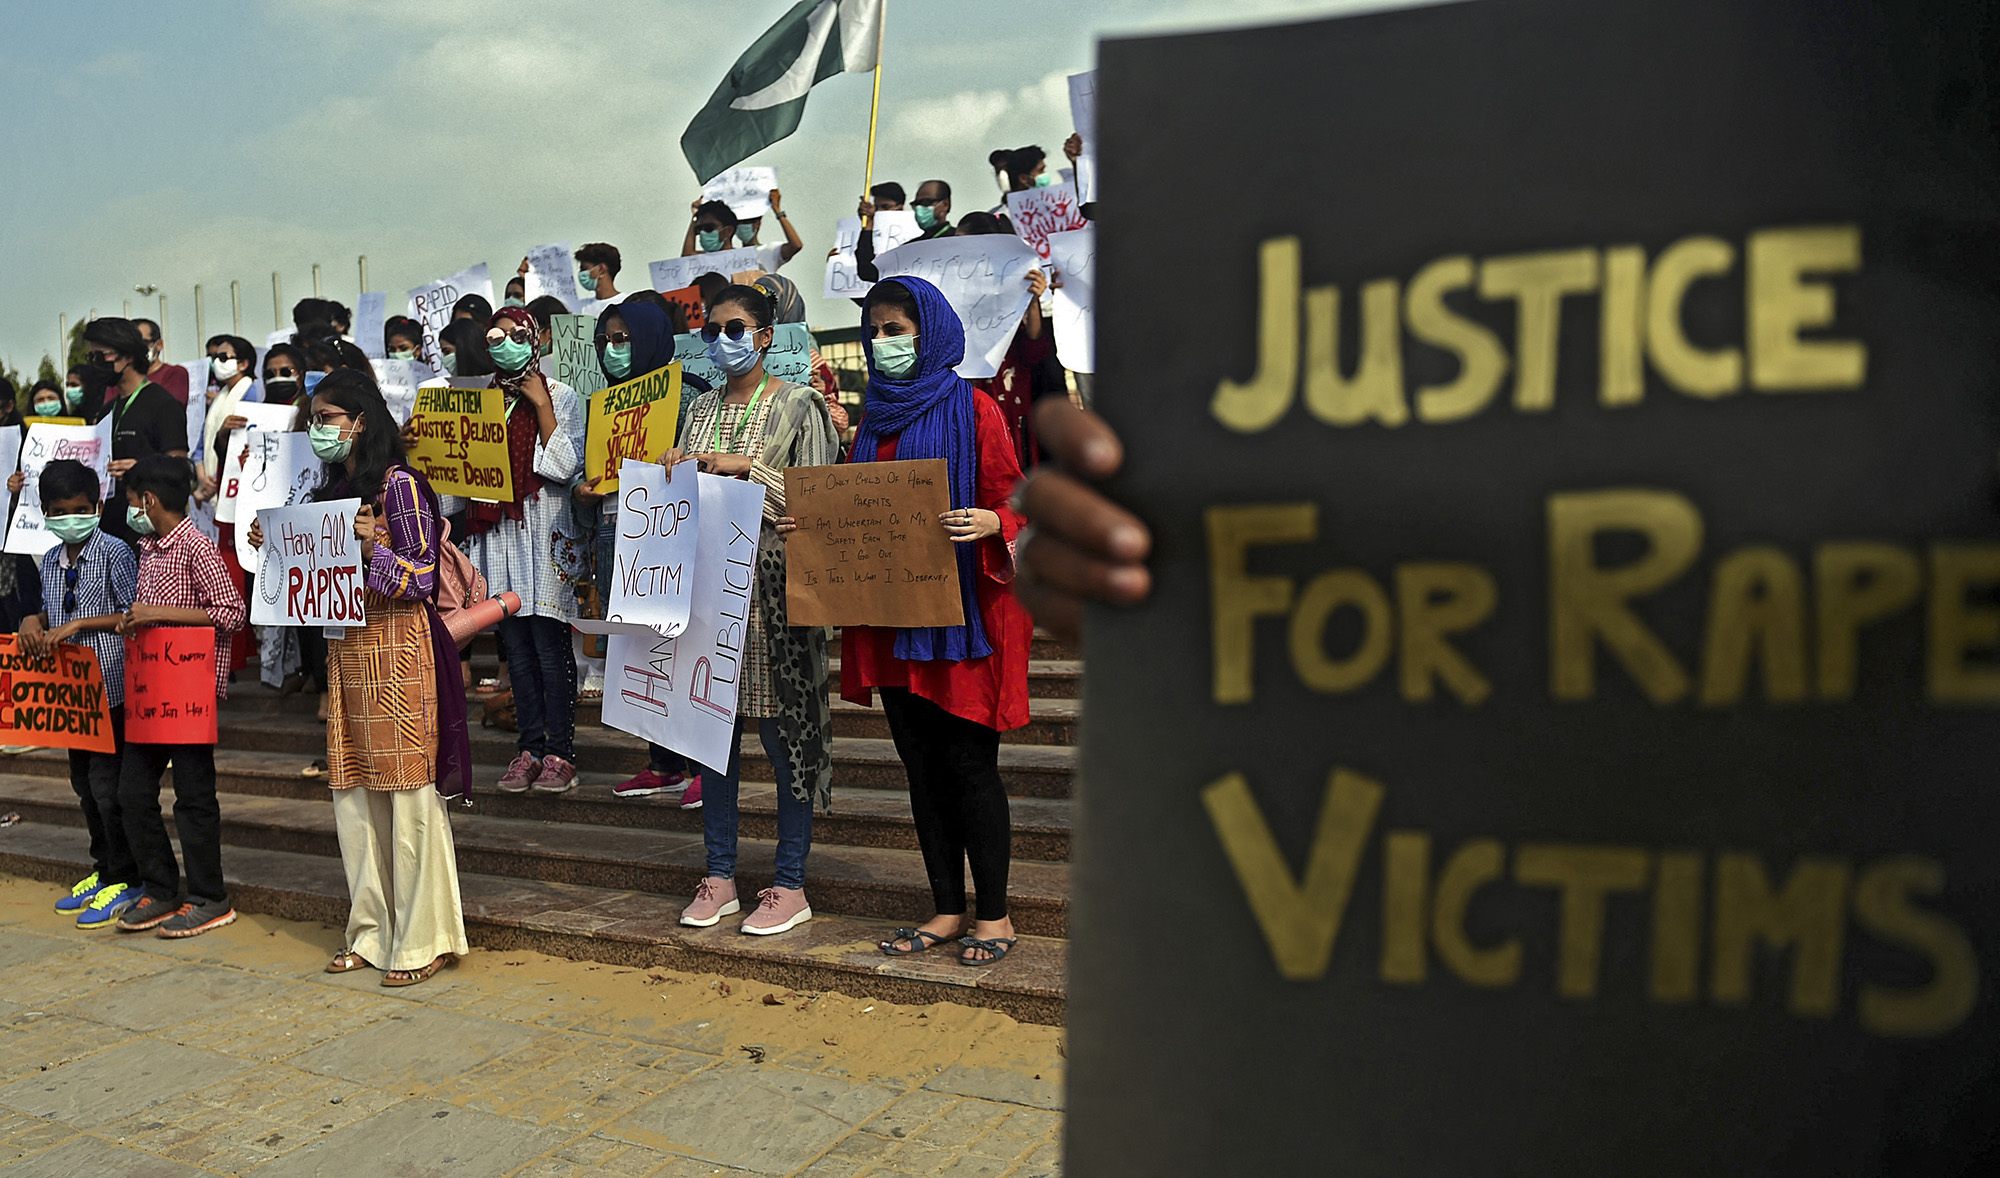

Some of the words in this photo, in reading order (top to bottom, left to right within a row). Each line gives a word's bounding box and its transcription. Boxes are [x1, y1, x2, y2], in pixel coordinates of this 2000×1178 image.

[415, 284, 459, 315] RAPID
[554, 314, 585, 341] WE
[557, 339, 594, 368] WANT
[558, 362, 606, 397] PAKISTA
[603, 368, 671, 416] #SAZAADO
[419, 388, 482, 414] #HANGTHEM
[411, 413, 456, 440] JUSTICE
[460, 415, 505, 444] DELAYED
[611, 402, 651, 435] STOP
[443, 439, 469, 460] IS
[606, 426, 648, 462] VICTIM
[417, 455, 459, 484] JUSTICE
[463, 461, 504, 489] DENIED
[797, 476, 817, 497] THE
[825, 473, 850, 491] ONLY
[855, 471, 881, 486] CHILD
[886, 471, 900, 485] OF
[907, 469, 934, 489] AGING
[622, 486, 691, 539] STOP
[853, 493, 892, 508] PARENTS
[799, 516, 810, 530] I
[816, 517, 832, 531] AM
[838, 517, 883, 528] UNCERTAIN
[909, 511, 928, 527] MY
[281, 521, 316, 573] Hang
[320, 510, 347, 559] All
[825, 532, 857, 547] SAFETY
[861, 532, 882, 544] EACH
[887, 530, 908, 543] TIME
[839, 550, 849, 563] I
[857, 549, 870, 561] GO
[878, 549, 893, 560] OUT
[618, 549, 683, 598] VICTIM
[804, 570, 818, 586] IS
[825, 567, 846, 585] THIS
[884, 568, 893, 584] I
[1205, 502, 1497, 708] FOR
[1545, 488, 2000, 708] RAPE
[689, 520, 755, 725] PUBLICLY
[620, 636, 674, 718] HAN
[1200, 766, 1981, 1037] VICTIMS
